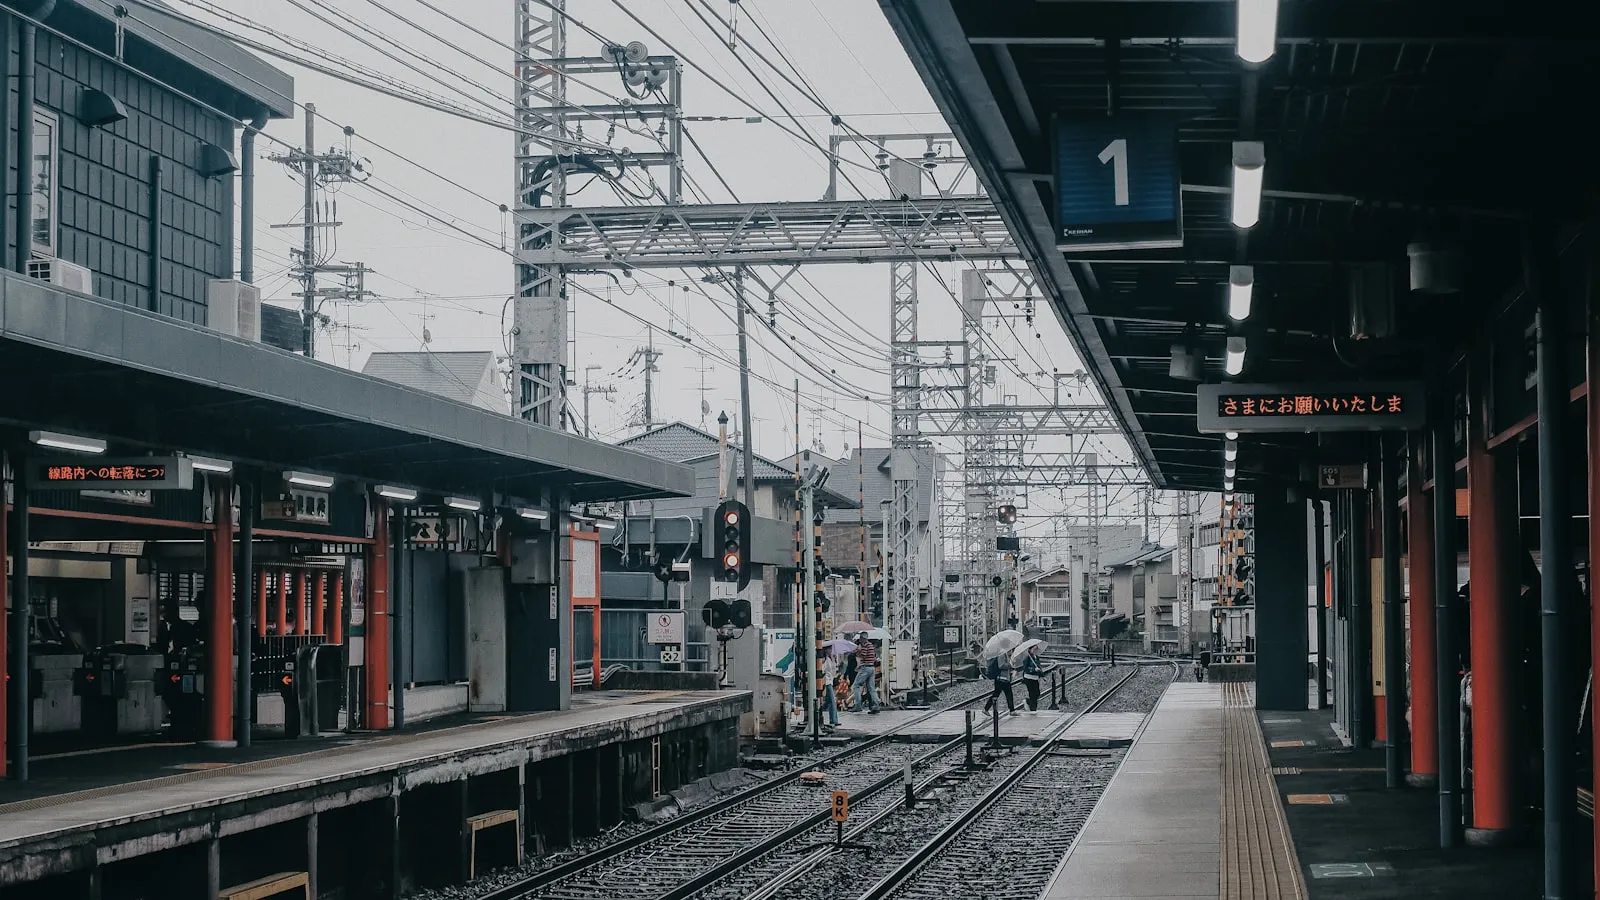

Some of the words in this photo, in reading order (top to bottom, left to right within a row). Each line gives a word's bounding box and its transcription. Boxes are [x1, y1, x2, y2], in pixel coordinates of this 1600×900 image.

[1098, 139, 1130, 206] 1
[1224, 394, 1404, 416] さまにお願いいたしま
